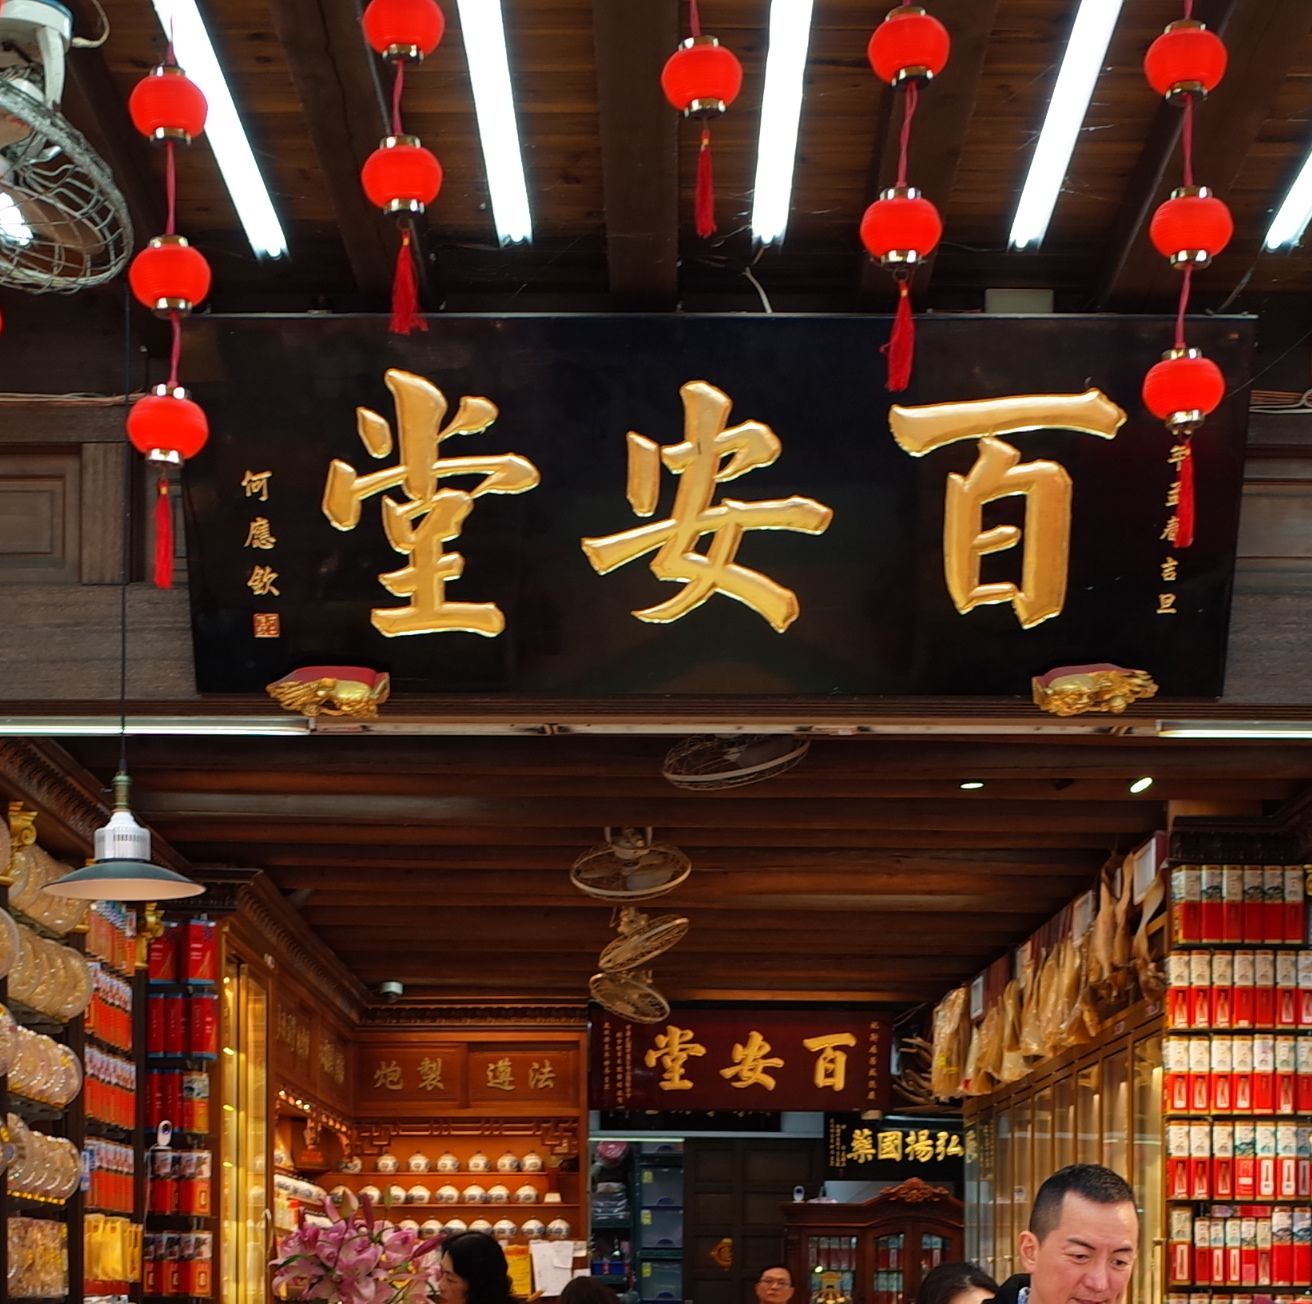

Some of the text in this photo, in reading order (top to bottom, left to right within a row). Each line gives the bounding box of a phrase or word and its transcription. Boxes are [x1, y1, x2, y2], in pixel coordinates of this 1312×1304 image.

[241, 470, 280, 597] 何應欽
[322, 368, 1127, 638] 百安堂
[645, 1025, 857, 1091] 百安堂
[847, 1128, 965, 1164] 弘揚國藥
